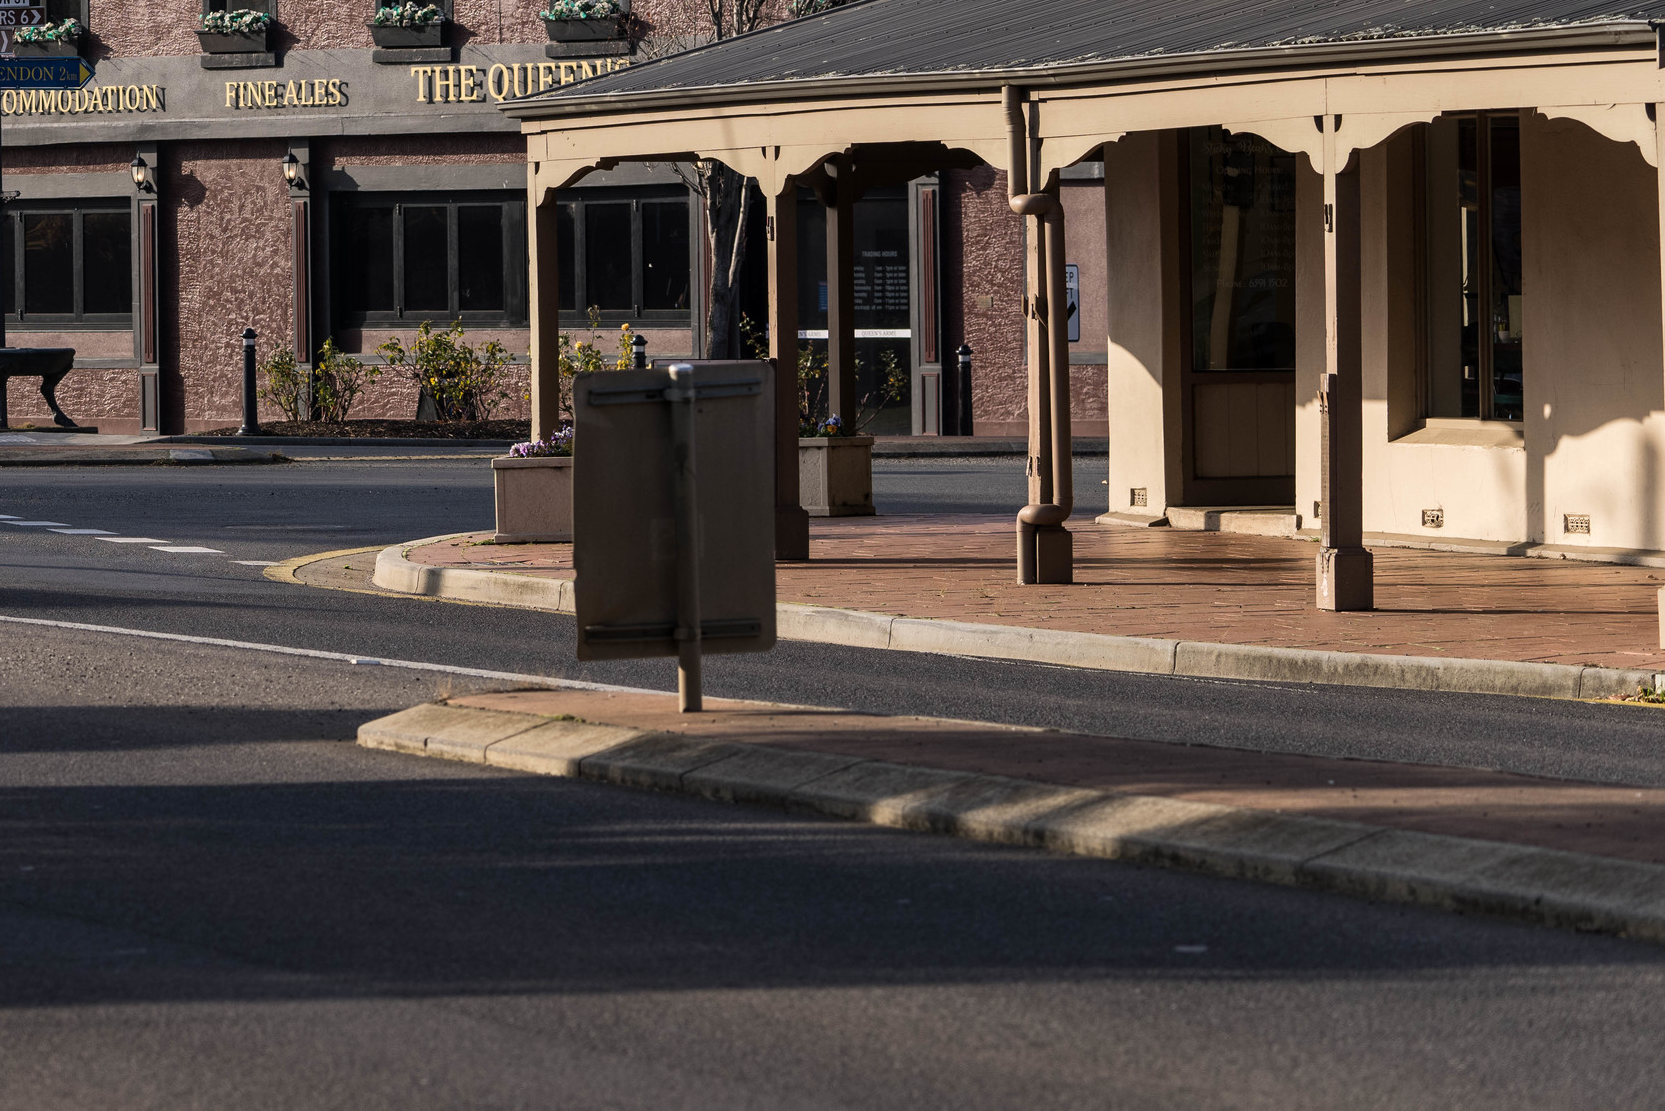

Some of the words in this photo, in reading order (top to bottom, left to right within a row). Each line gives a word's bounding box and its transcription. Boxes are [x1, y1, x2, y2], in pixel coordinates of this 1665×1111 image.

[20, 10, 29, 25] 6
[225, 81, 278, 107] FINE
[282, 79, 341, 105] ALES
[411, 64, 478, 102] THE
